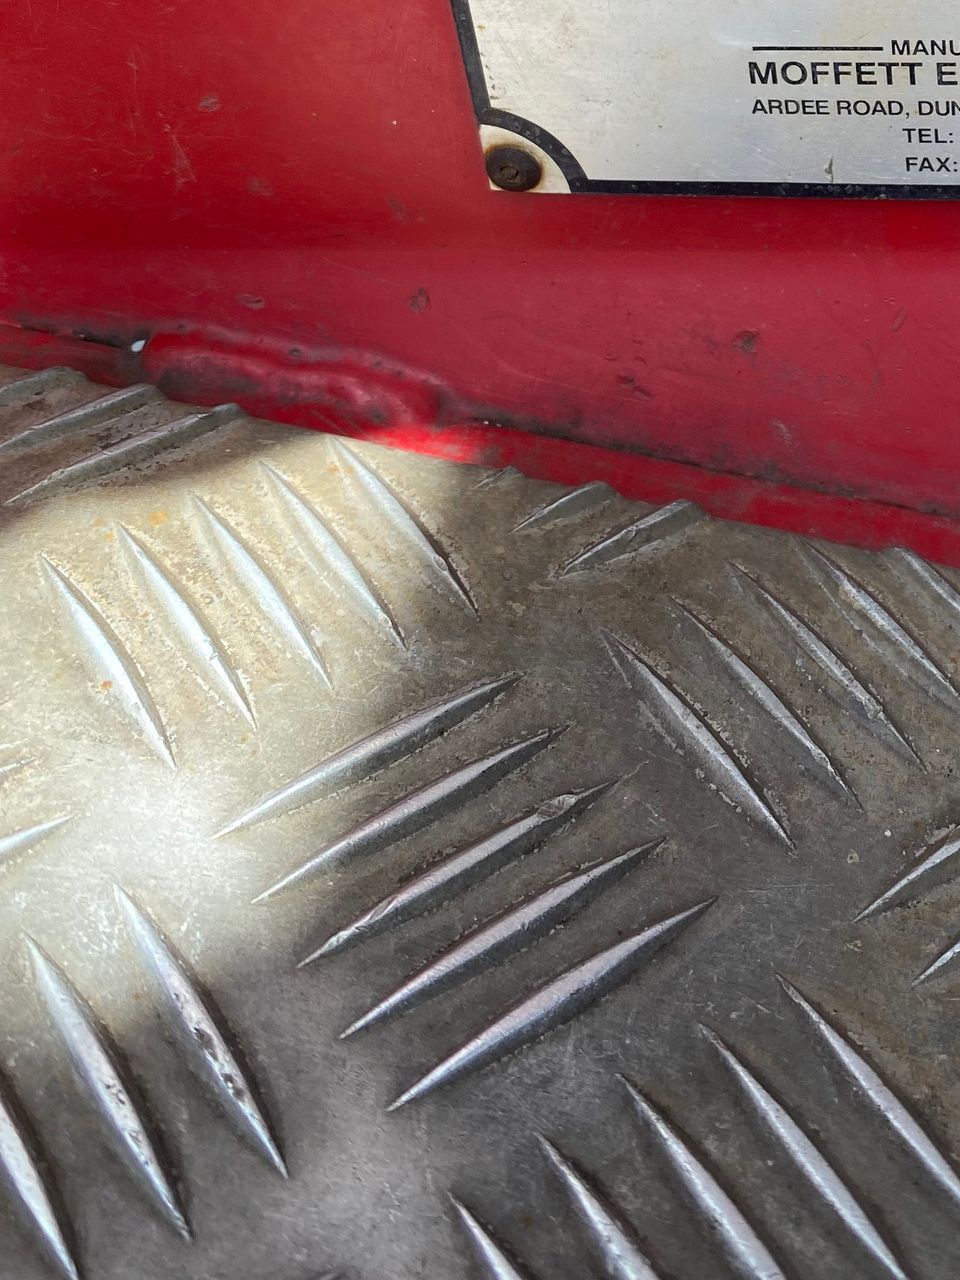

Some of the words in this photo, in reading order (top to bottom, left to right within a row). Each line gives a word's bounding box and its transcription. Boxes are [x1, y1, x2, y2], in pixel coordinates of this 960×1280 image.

[749, 61, 923, 86] MOFFETT
[751, 100, 830, 116] ARDEE
[836, 100, 910, 118] ROAD,
[903, 128, 953, 144] TEL:
[906, 157, 958, 173] FAX:
